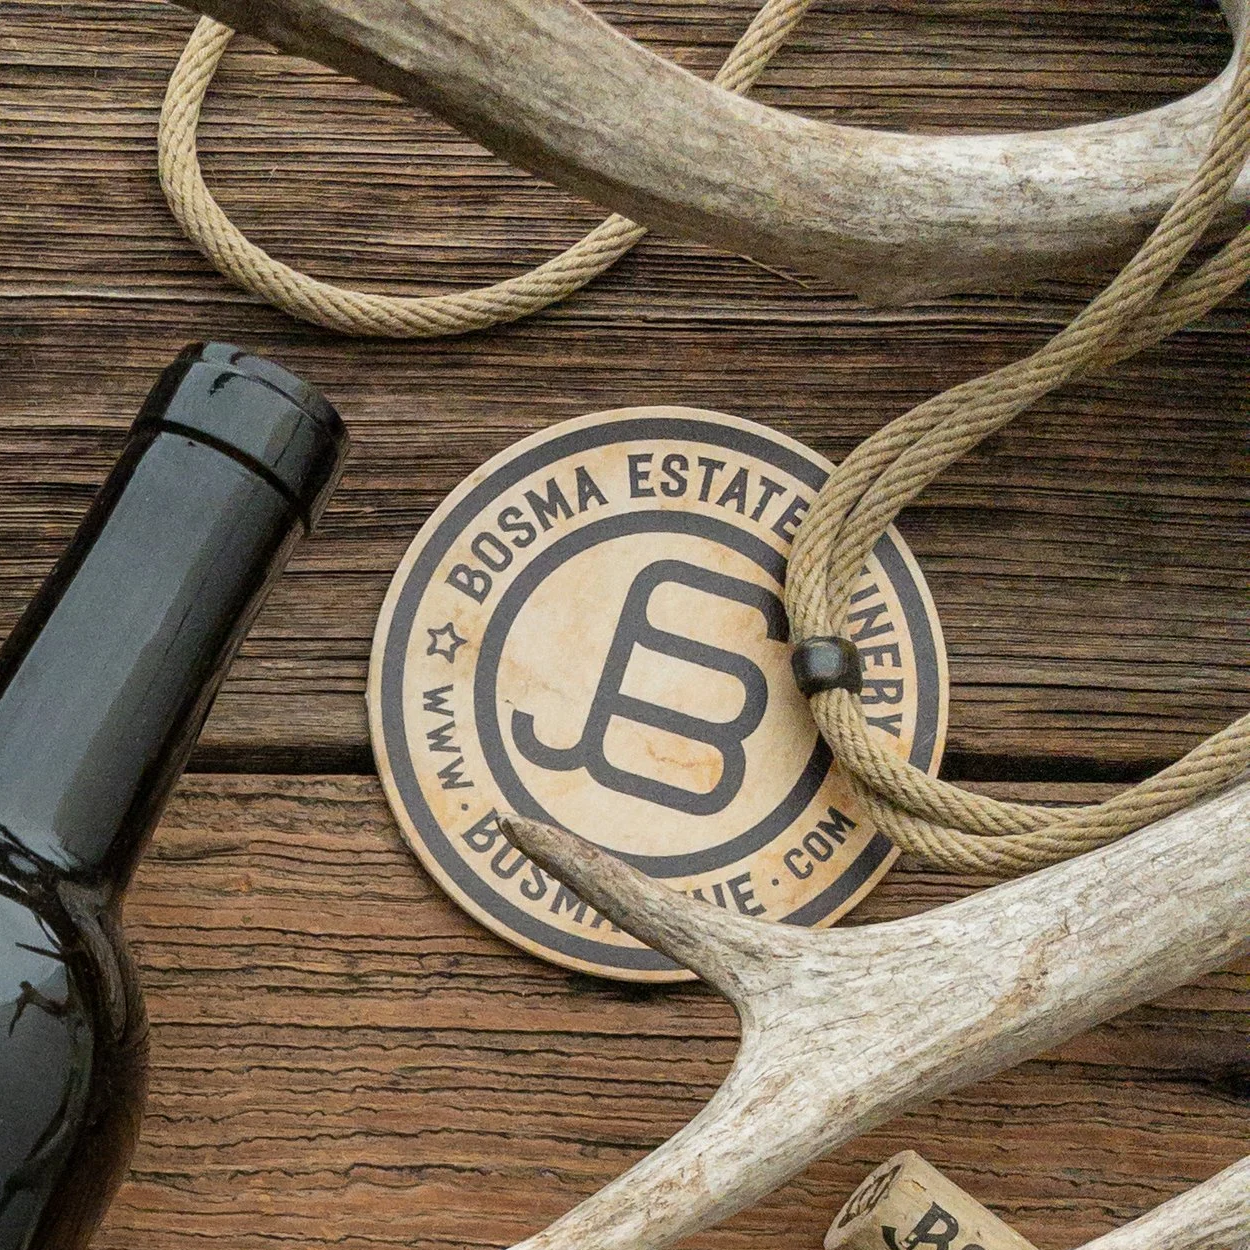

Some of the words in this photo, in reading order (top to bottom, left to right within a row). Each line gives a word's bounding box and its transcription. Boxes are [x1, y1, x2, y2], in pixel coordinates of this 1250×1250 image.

[444, 465, 608, 606] BOSMA
[627, 452, 811, 544] ESTATE
[848, 564, 905, 739] INERY
[422, 683, 475, 791] WWW
